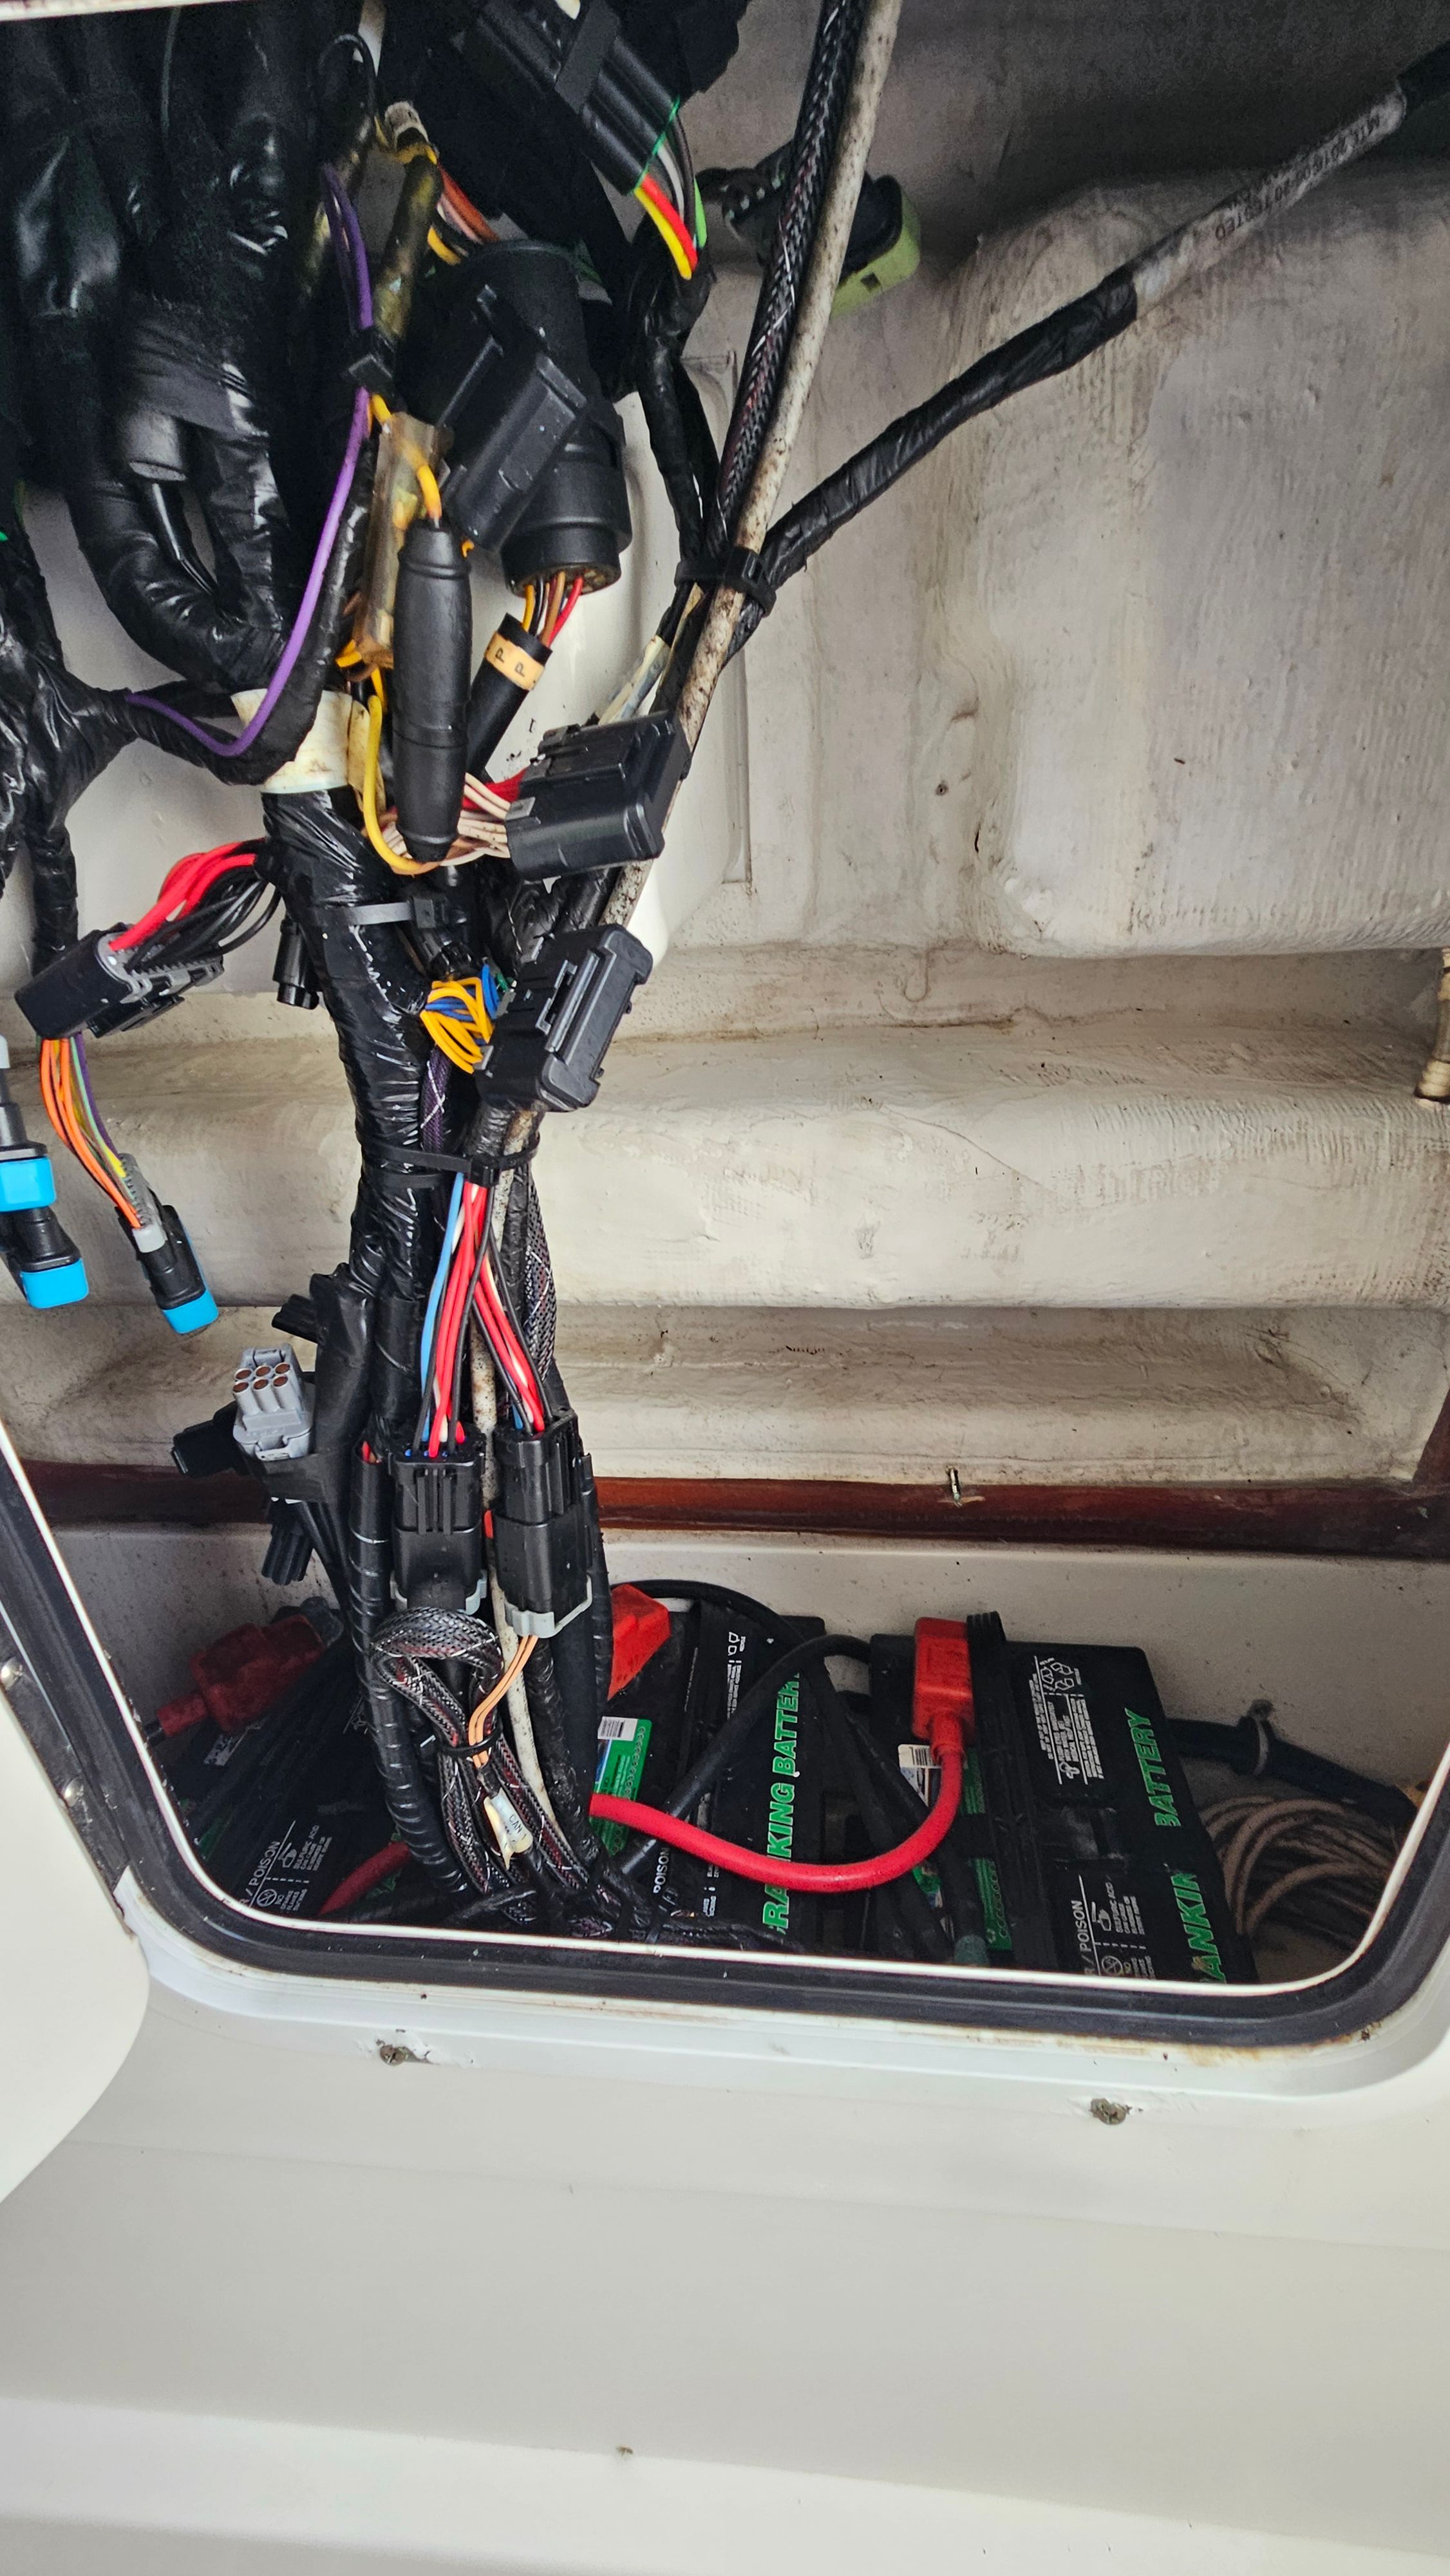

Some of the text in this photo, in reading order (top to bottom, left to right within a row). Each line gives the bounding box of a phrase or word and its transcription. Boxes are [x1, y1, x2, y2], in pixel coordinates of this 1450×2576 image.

[772, 1672, 800, 1777] BATTER
[1124, 1707, 1182, 1827] BATTERY
[248, 1841, 281, 1886] POISON
[652, 1847, 670, 1894] POISON
[1071, 1900, 1092, 1953] POISON
